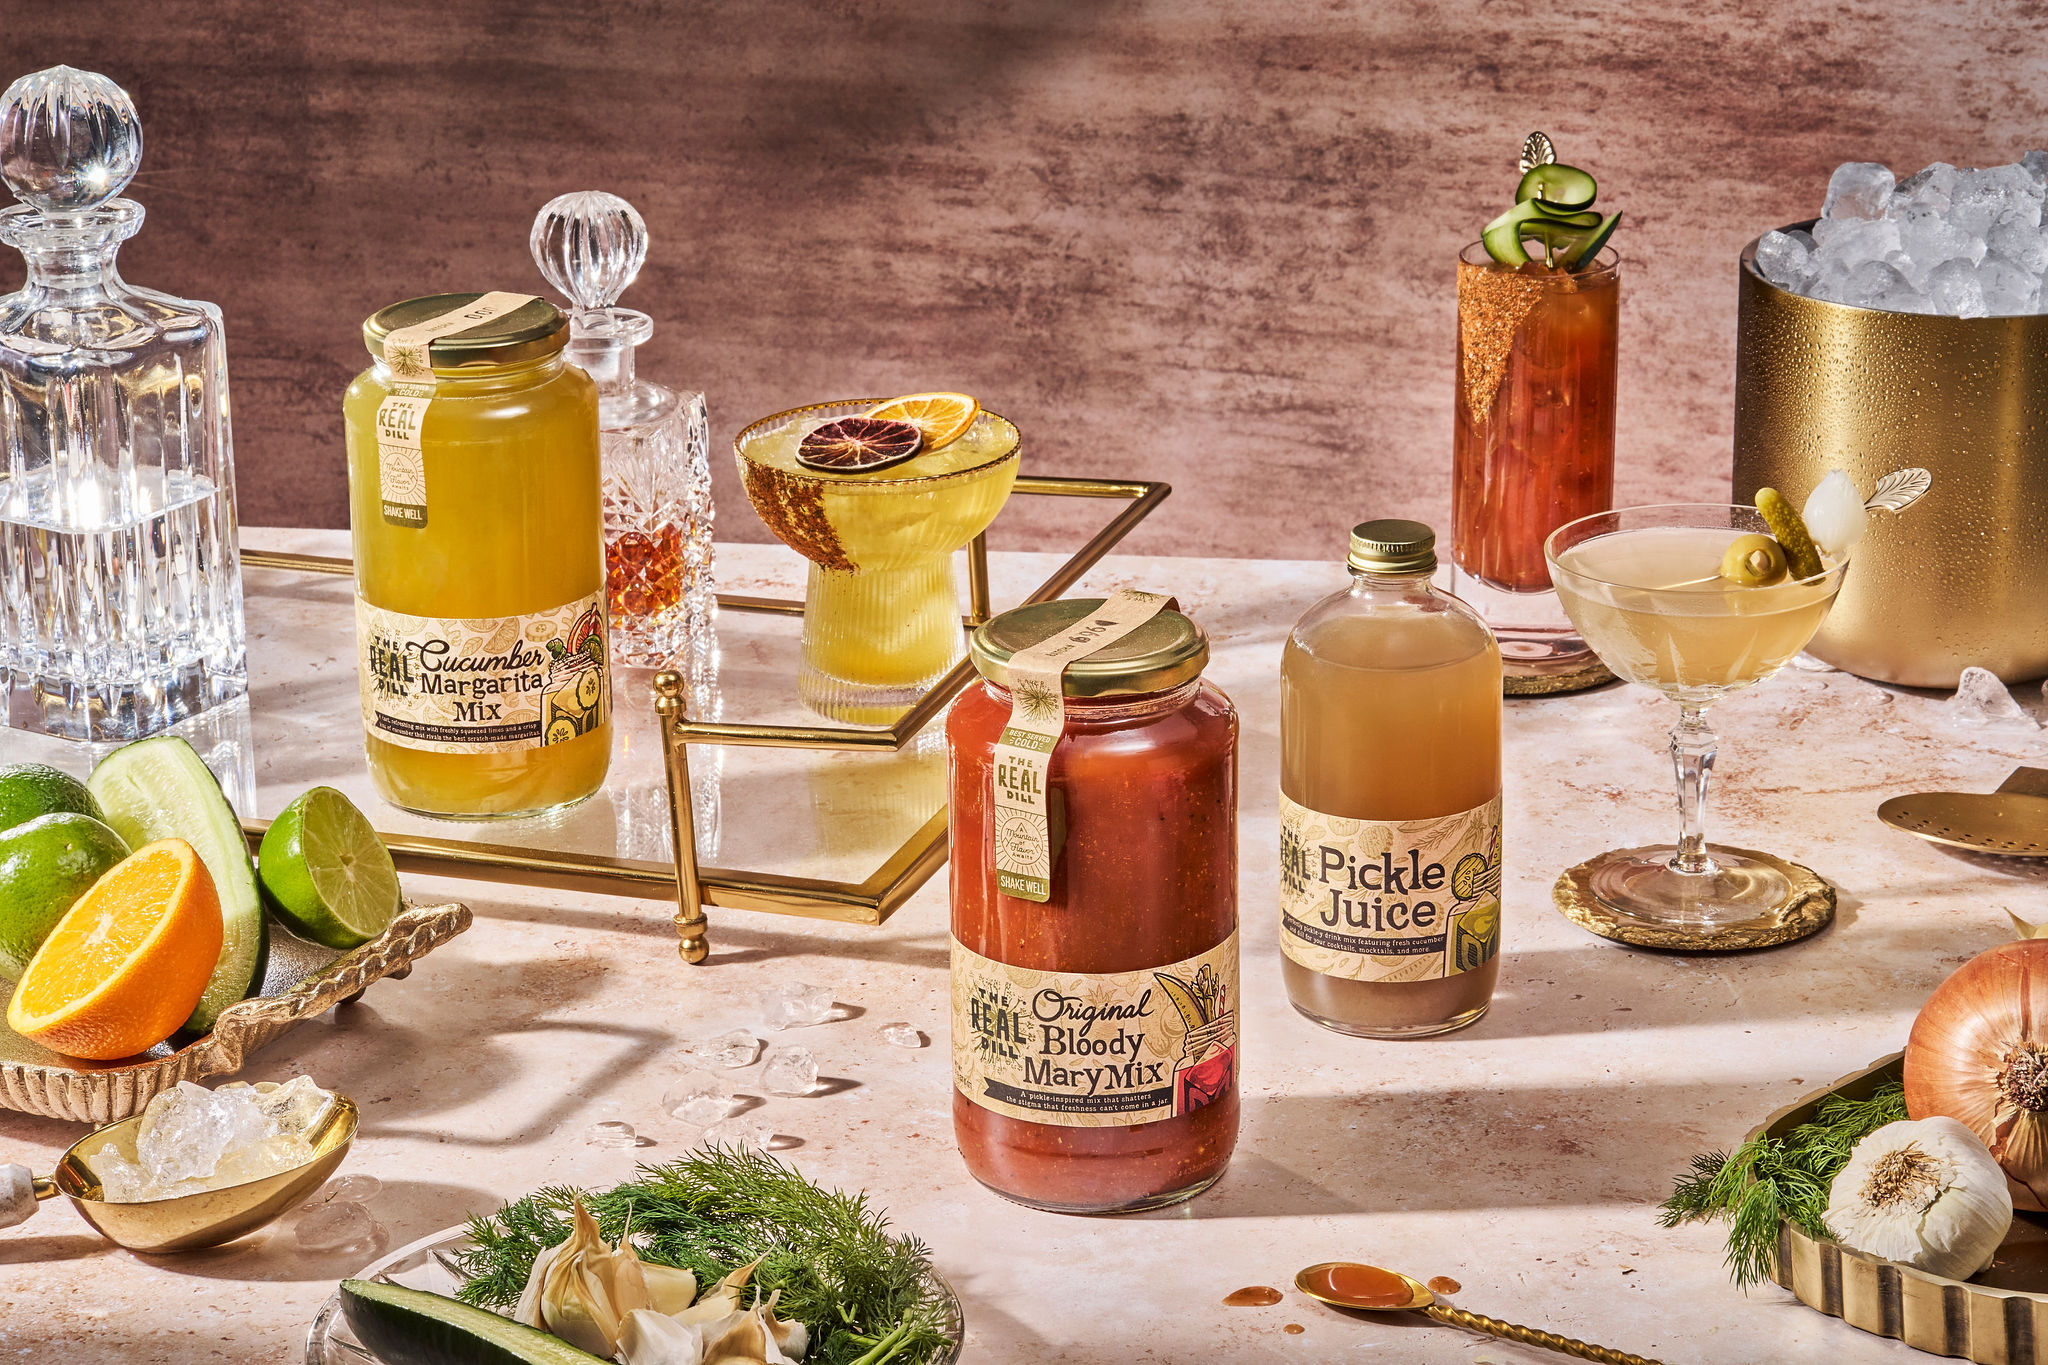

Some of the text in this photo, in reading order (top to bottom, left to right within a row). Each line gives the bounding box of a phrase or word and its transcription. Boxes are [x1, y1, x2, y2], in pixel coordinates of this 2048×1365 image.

[378, 408, 416, 430] REAL
[386, 430, 410, 440] DILL
[384, 505, 422, 520] SHAKE WELL
[374, 636, 398, 650] THE
[370, 645, 414, 683] REAL
[406, 640, 545, 672] Cucumber
[378, 678, 408, 696] DILL
[420, 670, 543, 699] Margarita
[453, 702, 502, 722] Mix
[1009, 730, 1051, 743] BEST SERVED
[1014, 738, 1038, 750] COLD
[1009, 756, 1032, 768] THE
[998, 764, 1042, 794] REAL
[1007, 790, 1035, 804] DILL
[1282, 825, 1300, 844] THE
[1318, 845, 1445, 895] Pickle
[1000, 876, 1046, 896] SHAKE WELL
[1284, 870, 1305, 894] DILL
[1320, 889, 1436, 932] Juice
[1304, 925, 1323, 938] pickle-y
[1324, 932, 1342, 942] drink
[1358, 938, 1390, 947] featuring
[1412, 937, 1444, 945] cucumber
[1314, 938, 1326, 946] your
[1327, 942, 1356, 952] cocktails,
[978, 987, 1010, 1008] THE
[971, 997, 1026, 1044] REAL
[1032, 988, 1156, 1038] Original
[981, 1040, 1018, 1060] DILL
[1039, 1024, 1146, 1062] Bloody
[1022, 1056, 1164, 1097] Mary Mix
[1006, 1096, 1016, 1104] the
[1018, 1100, 1042, 1108] stigma
[1061, 1103, 1096, 1112] freshness
[1029, 1094, 1084, 1104] pickle-inspired
[1122, 1094, 1152, 1102] shatters
